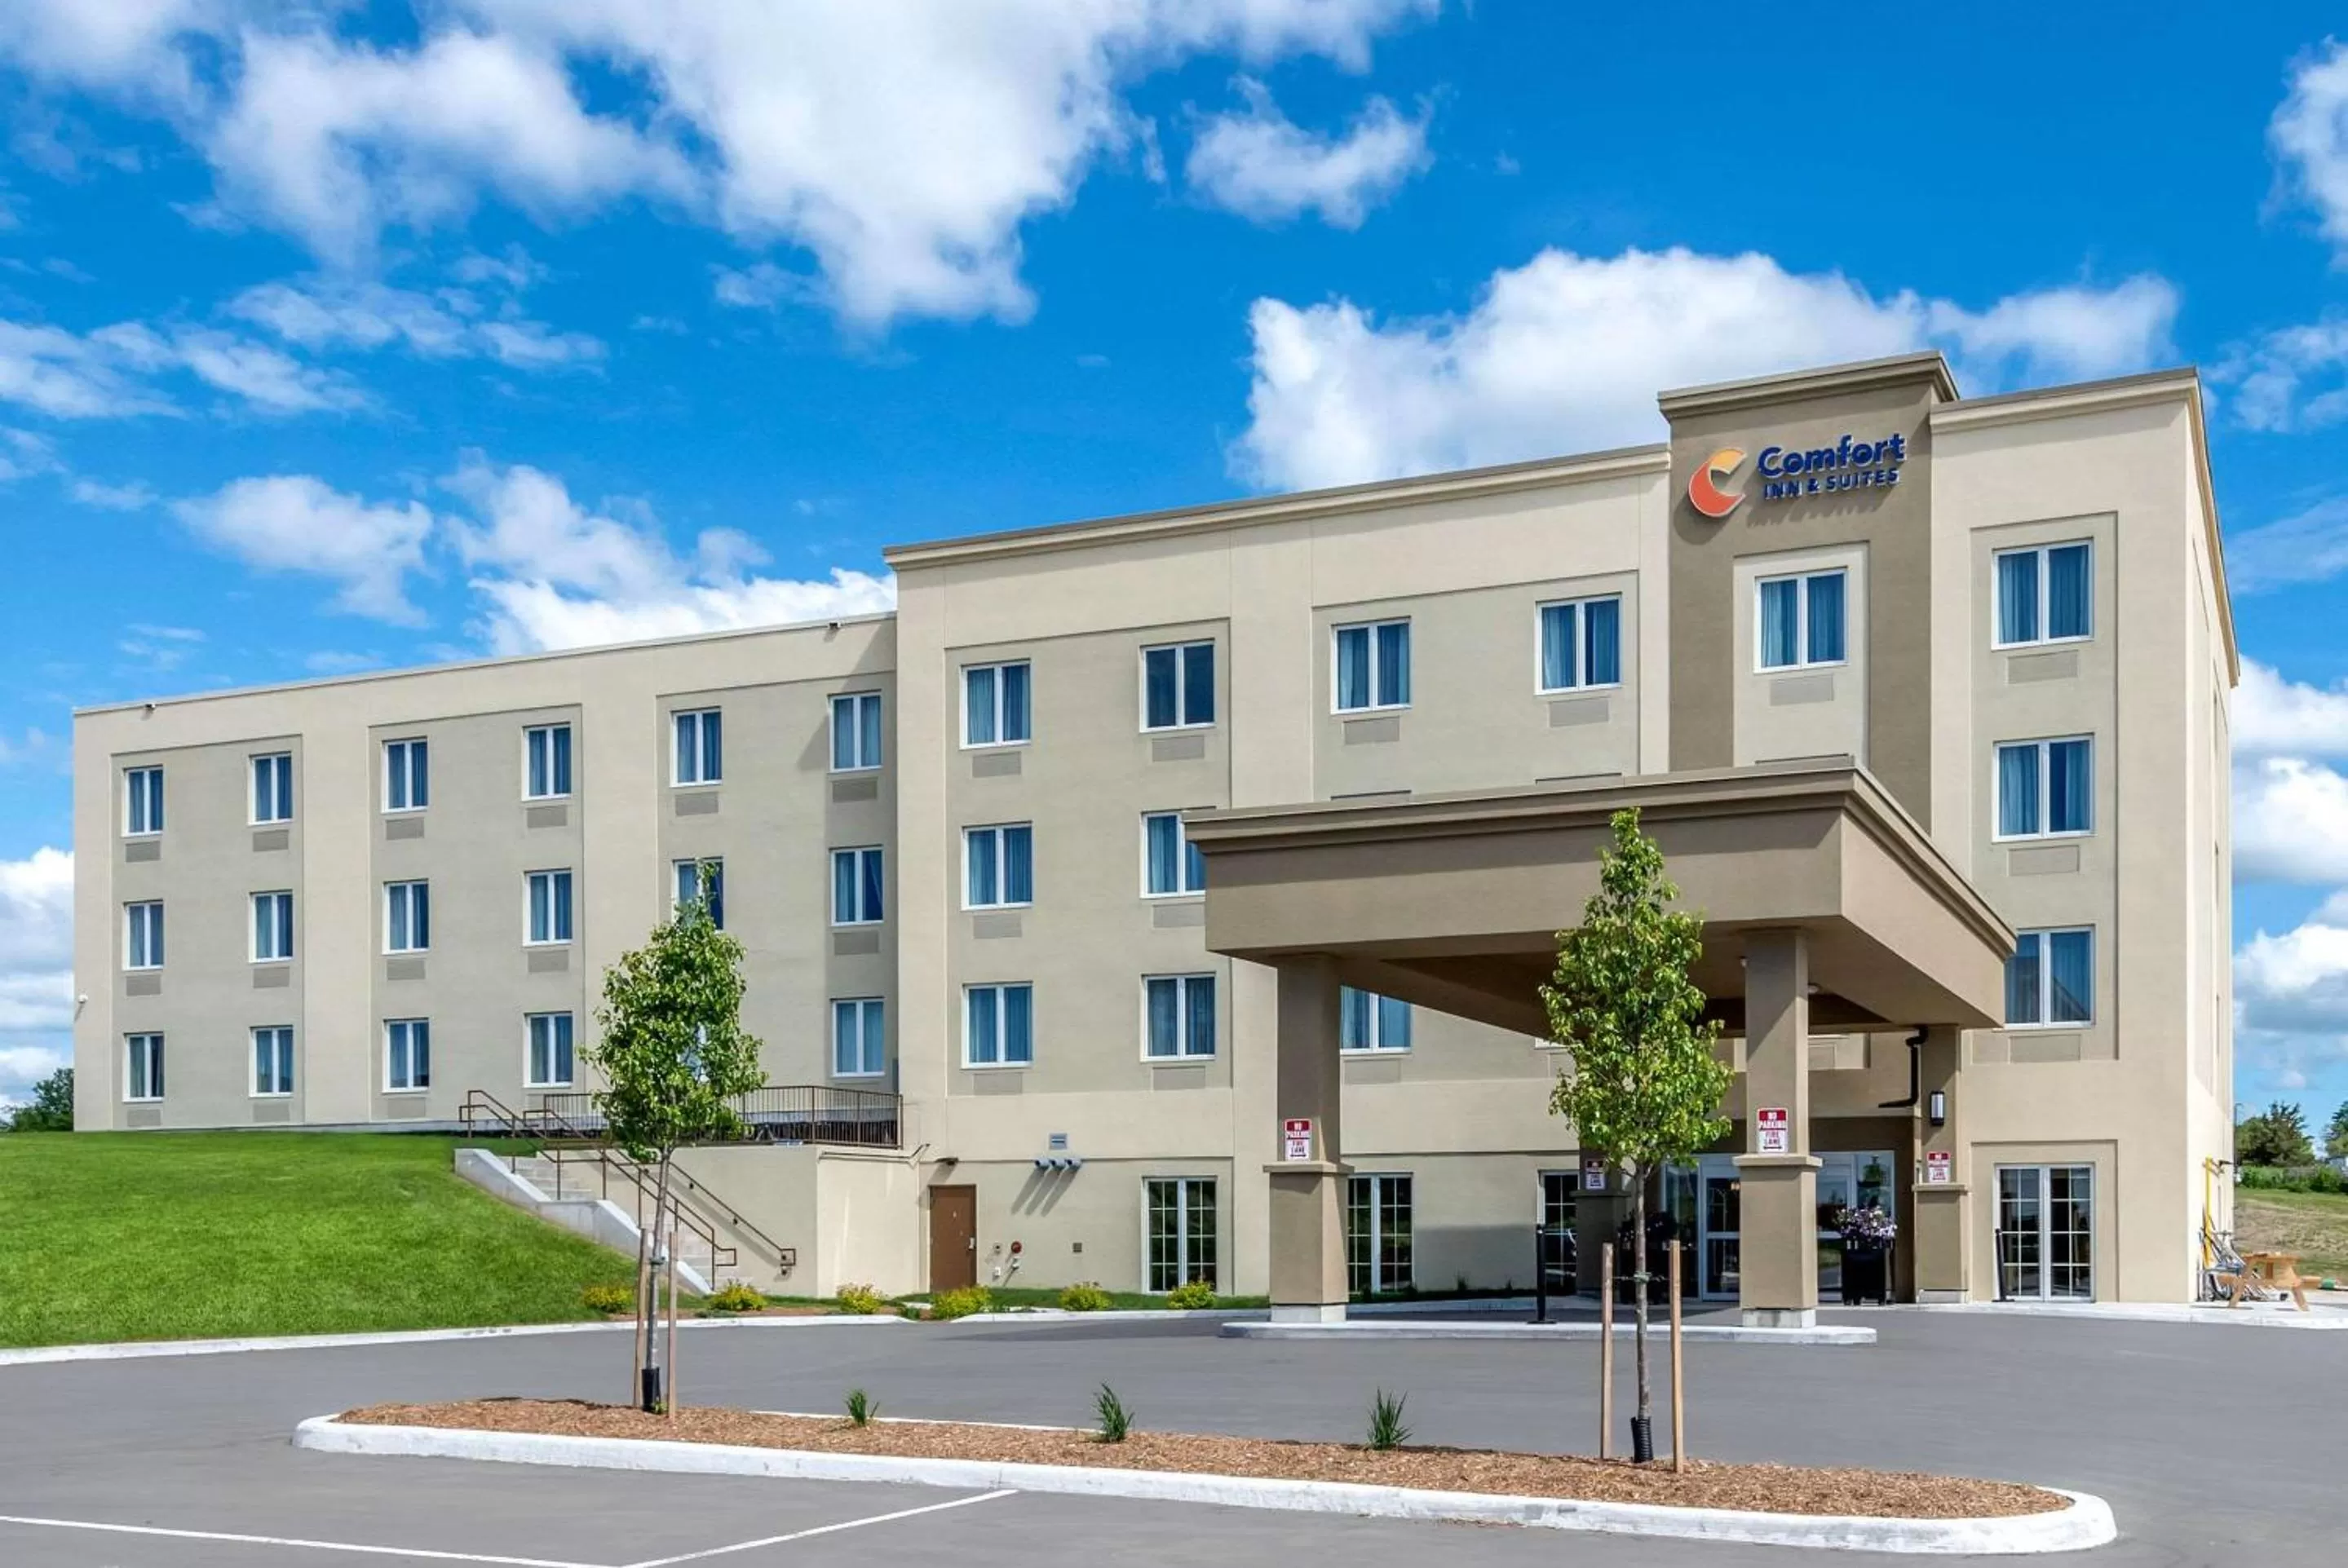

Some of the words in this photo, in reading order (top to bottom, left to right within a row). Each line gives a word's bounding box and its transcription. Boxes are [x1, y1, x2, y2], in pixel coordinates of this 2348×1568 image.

[1758, 433, 1907, 478] Comfort
[1763, 481, 1802, 500] INN
[1807, 477, 1820, 494] &
[1826, 467, 1899, 492] SUITES
